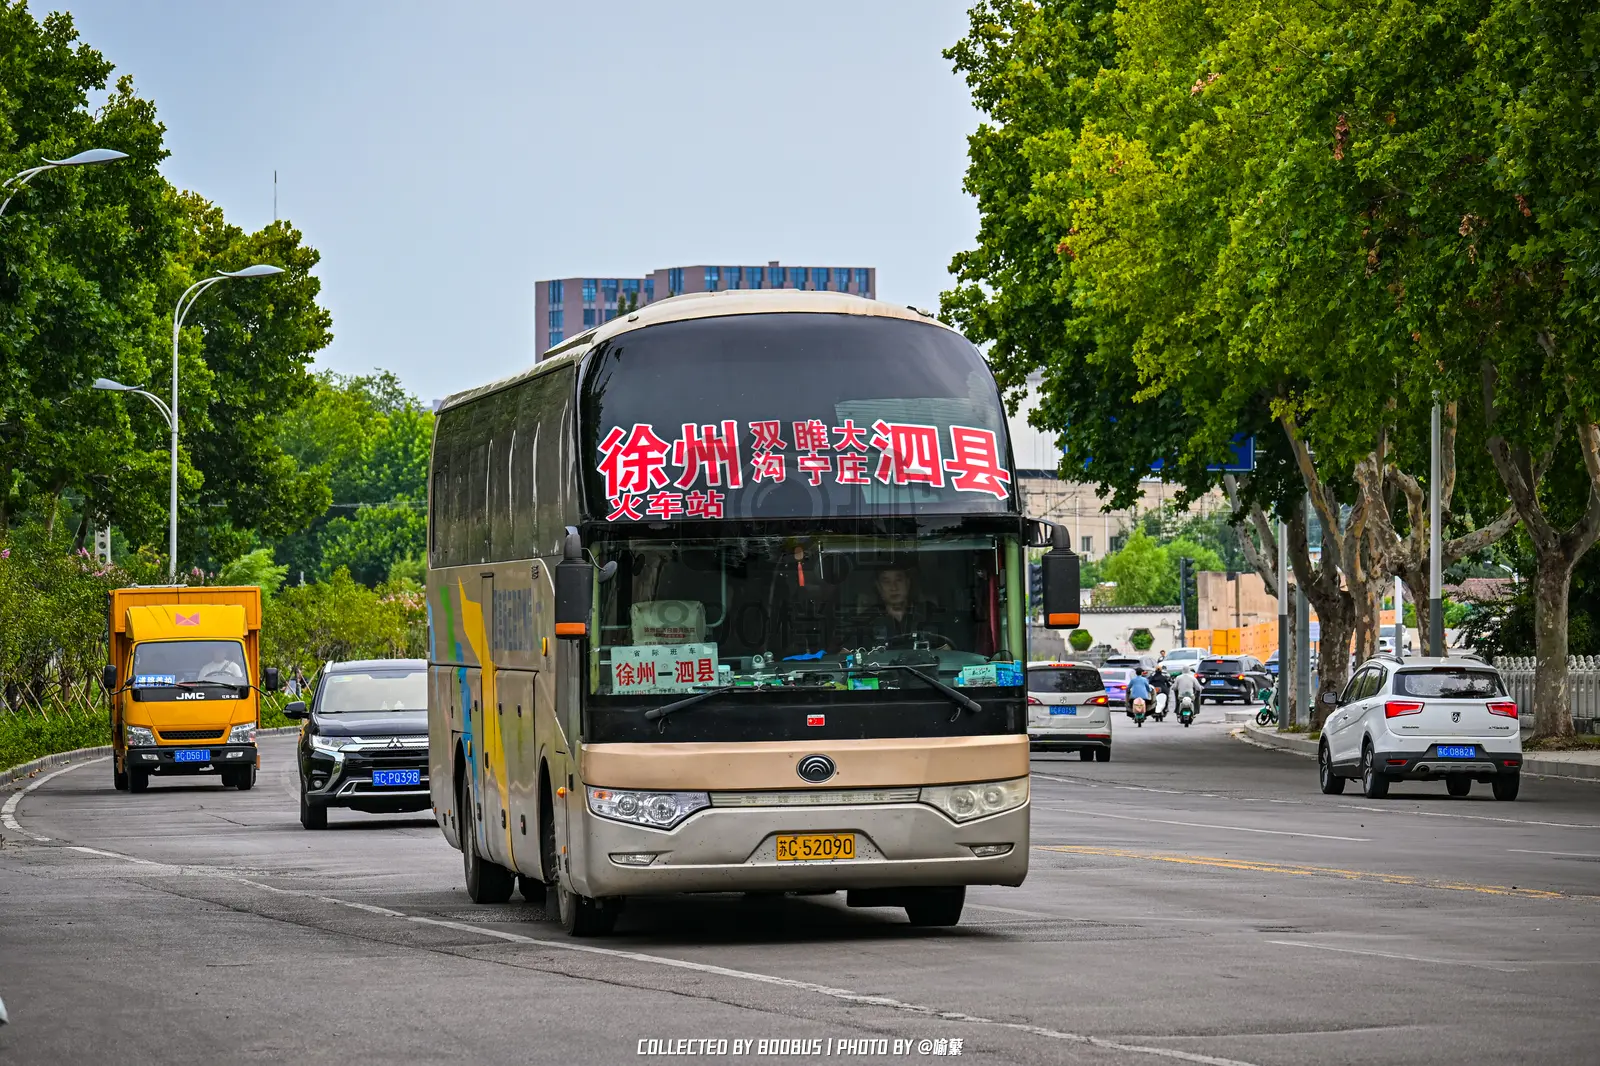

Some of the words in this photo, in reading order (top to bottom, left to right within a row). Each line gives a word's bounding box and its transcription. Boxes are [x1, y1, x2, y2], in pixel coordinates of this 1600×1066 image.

[597, 419, 744, 499] 徐州
[870, 419, 1011, 500] 泗县
[605, 489, 725, 522] 火车站
[633, 647, 697, 658] 省际班车
[175, 692, 206, 700] JMC
